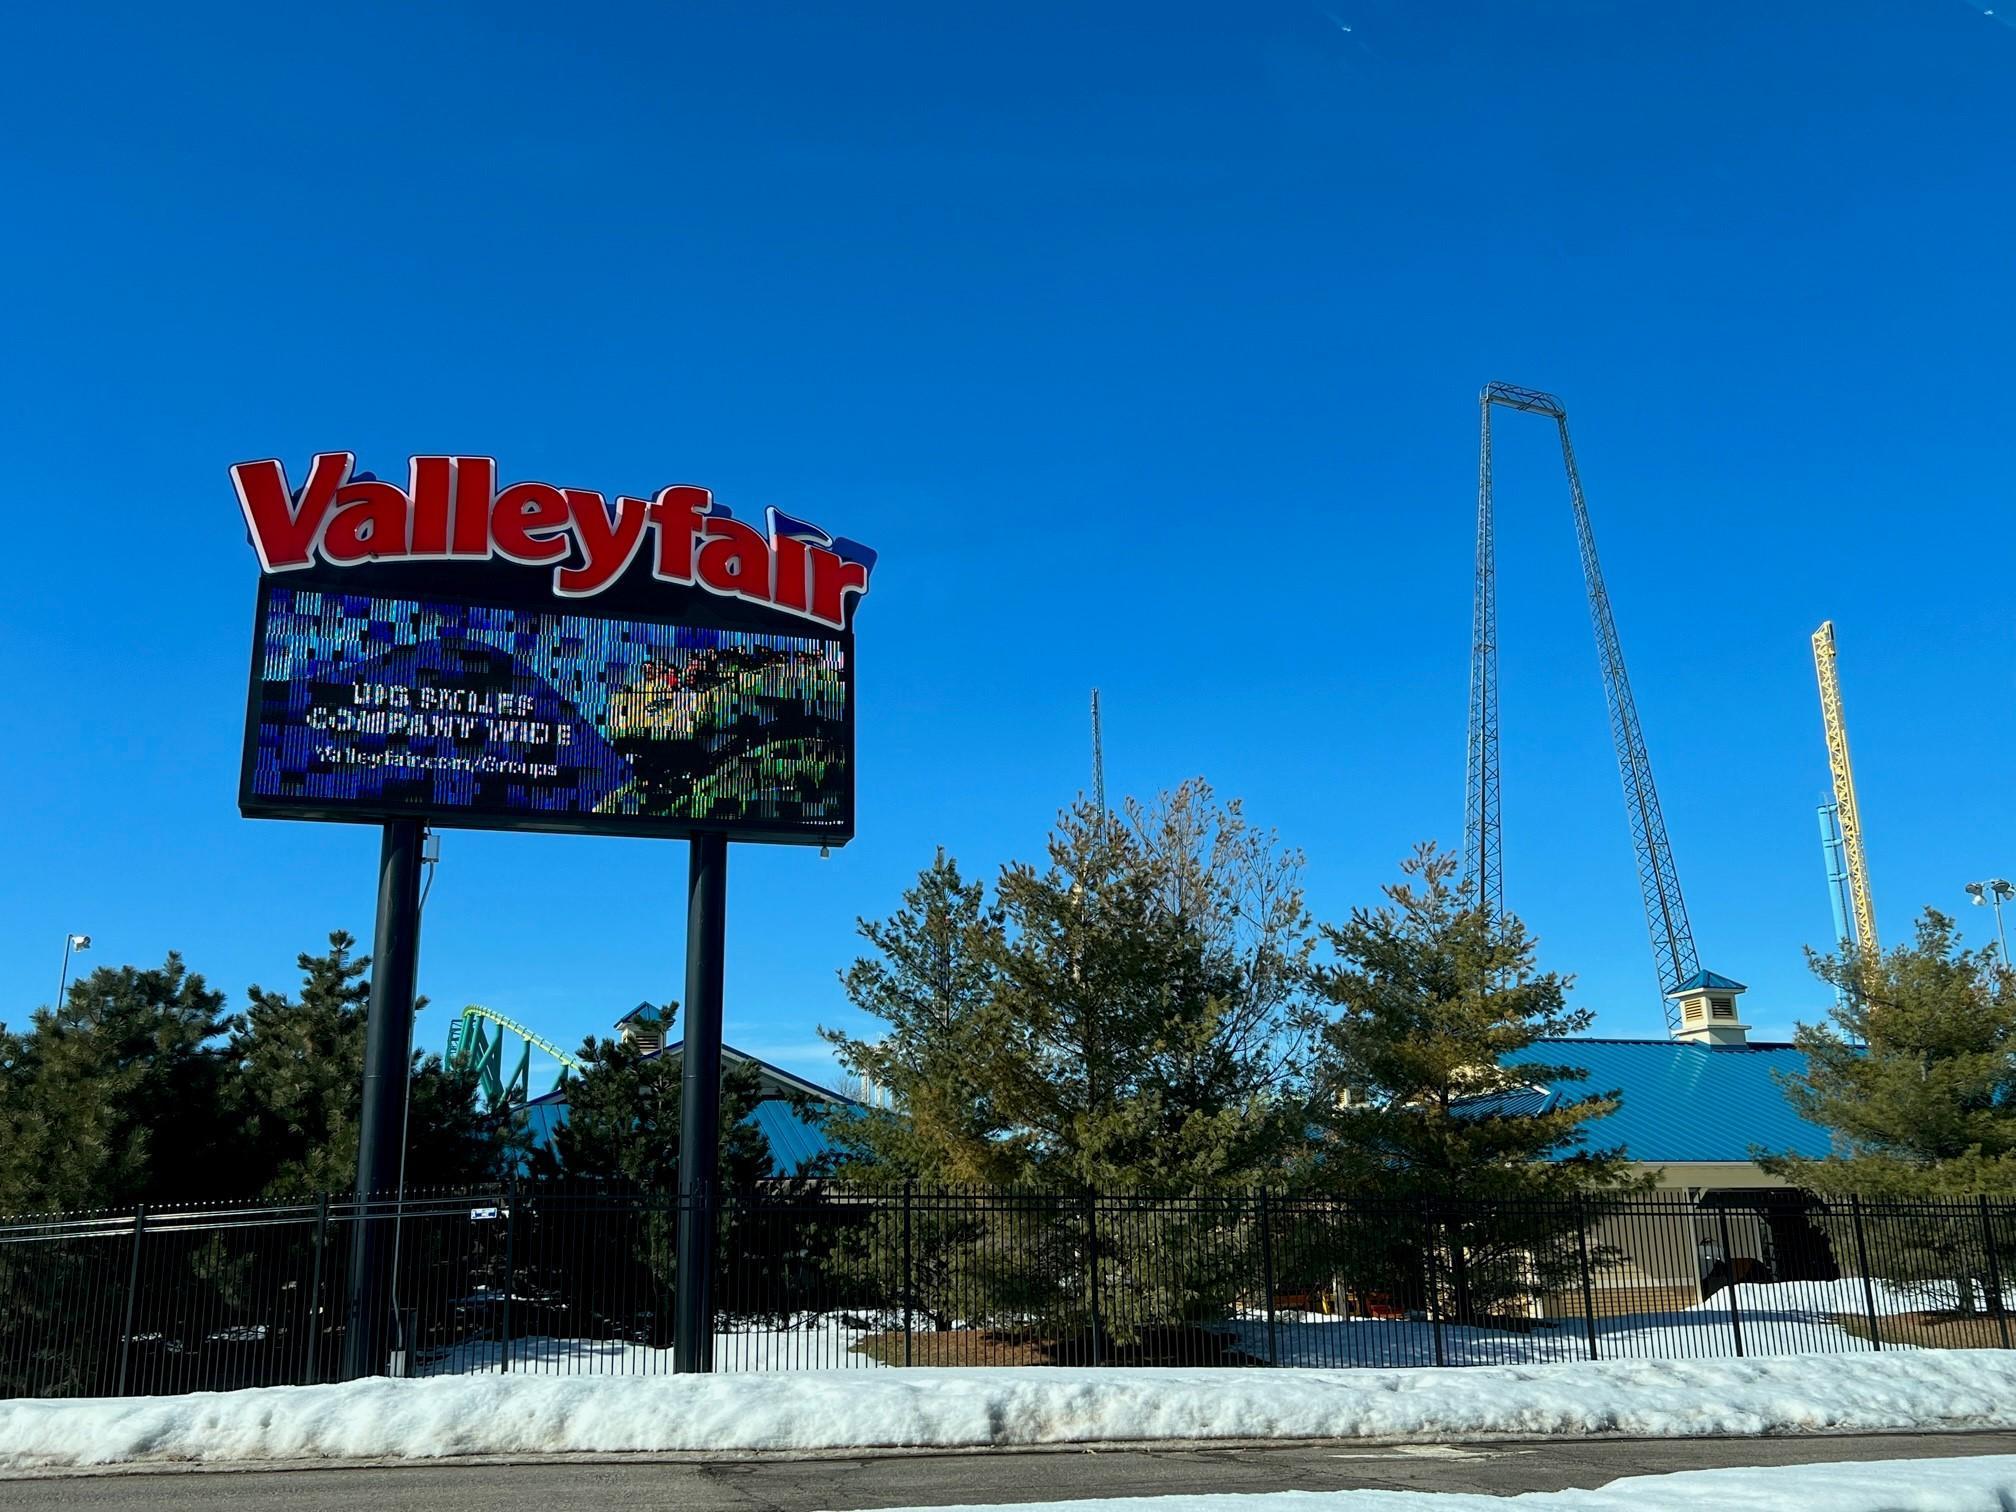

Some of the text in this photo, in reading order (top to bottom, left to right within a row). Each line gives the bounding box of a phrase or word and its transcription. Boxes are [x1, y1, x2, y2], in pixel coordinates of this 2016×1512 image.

[230, 451, 868, 630] Valleyfair
[305, 706, 572, 746] COMPANY WIDE
